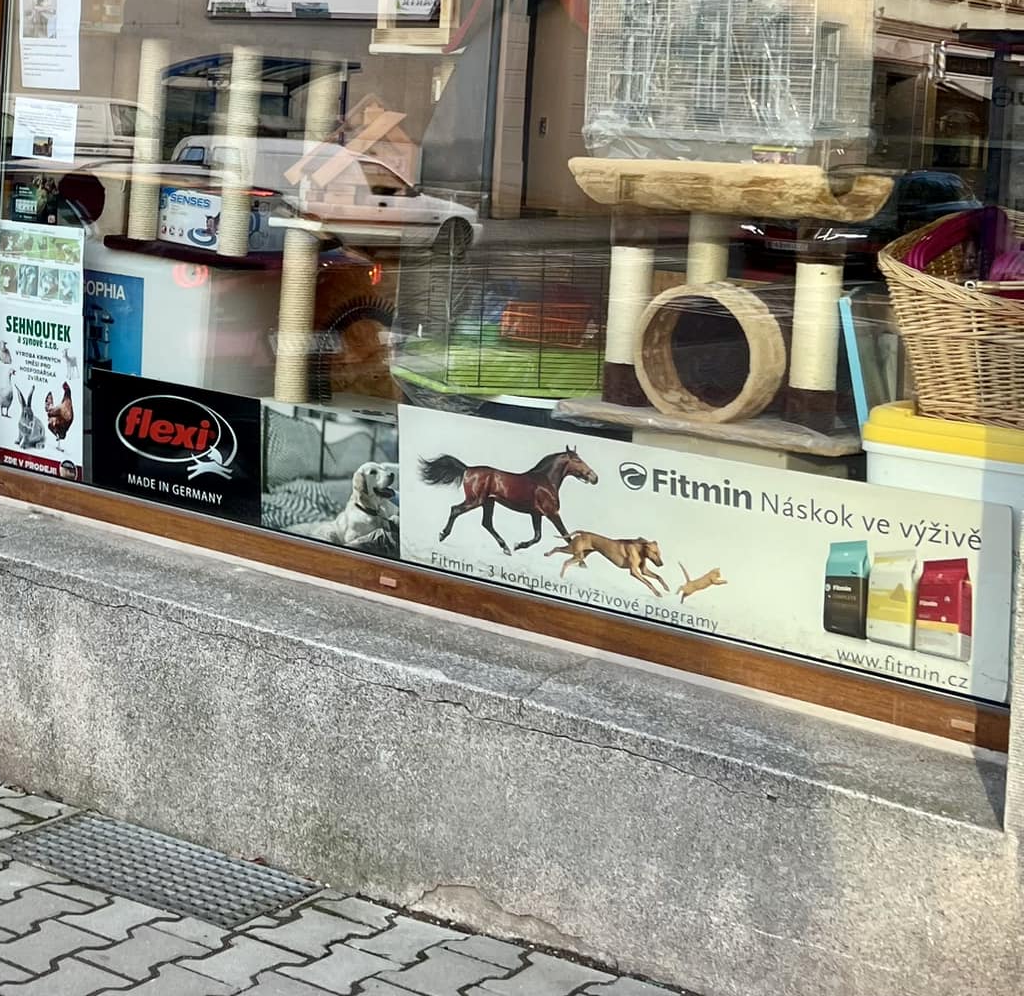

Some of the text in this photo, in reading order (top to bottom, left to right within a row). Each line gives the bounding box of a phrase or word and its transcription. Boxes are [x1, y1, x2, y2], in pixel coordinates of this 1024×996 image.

[170, 193, 211, 208] SENSES
[5, 315, 71, 343] SEHNOUTEK
[22, 337, 43, 348] synové
[125, 406, 210, 451] flexi
[3, 455, 18, 466] ZDE
[18, 459, 24, 468] V
[127, 473, 224, 506] MADE IN GERMANY
[652, 468, 982, 551] Fitmin Náskok ve výživě
[431, 551, 474, 574] Fitmin
[487, 564, 495, 578] 3
[500, 566, 574, 597] komplexní
[577, 588, 640, 612] výživové
[644, 602, 719, 633] programy
[836, 648, 969, 689] www.fitmin.cz
